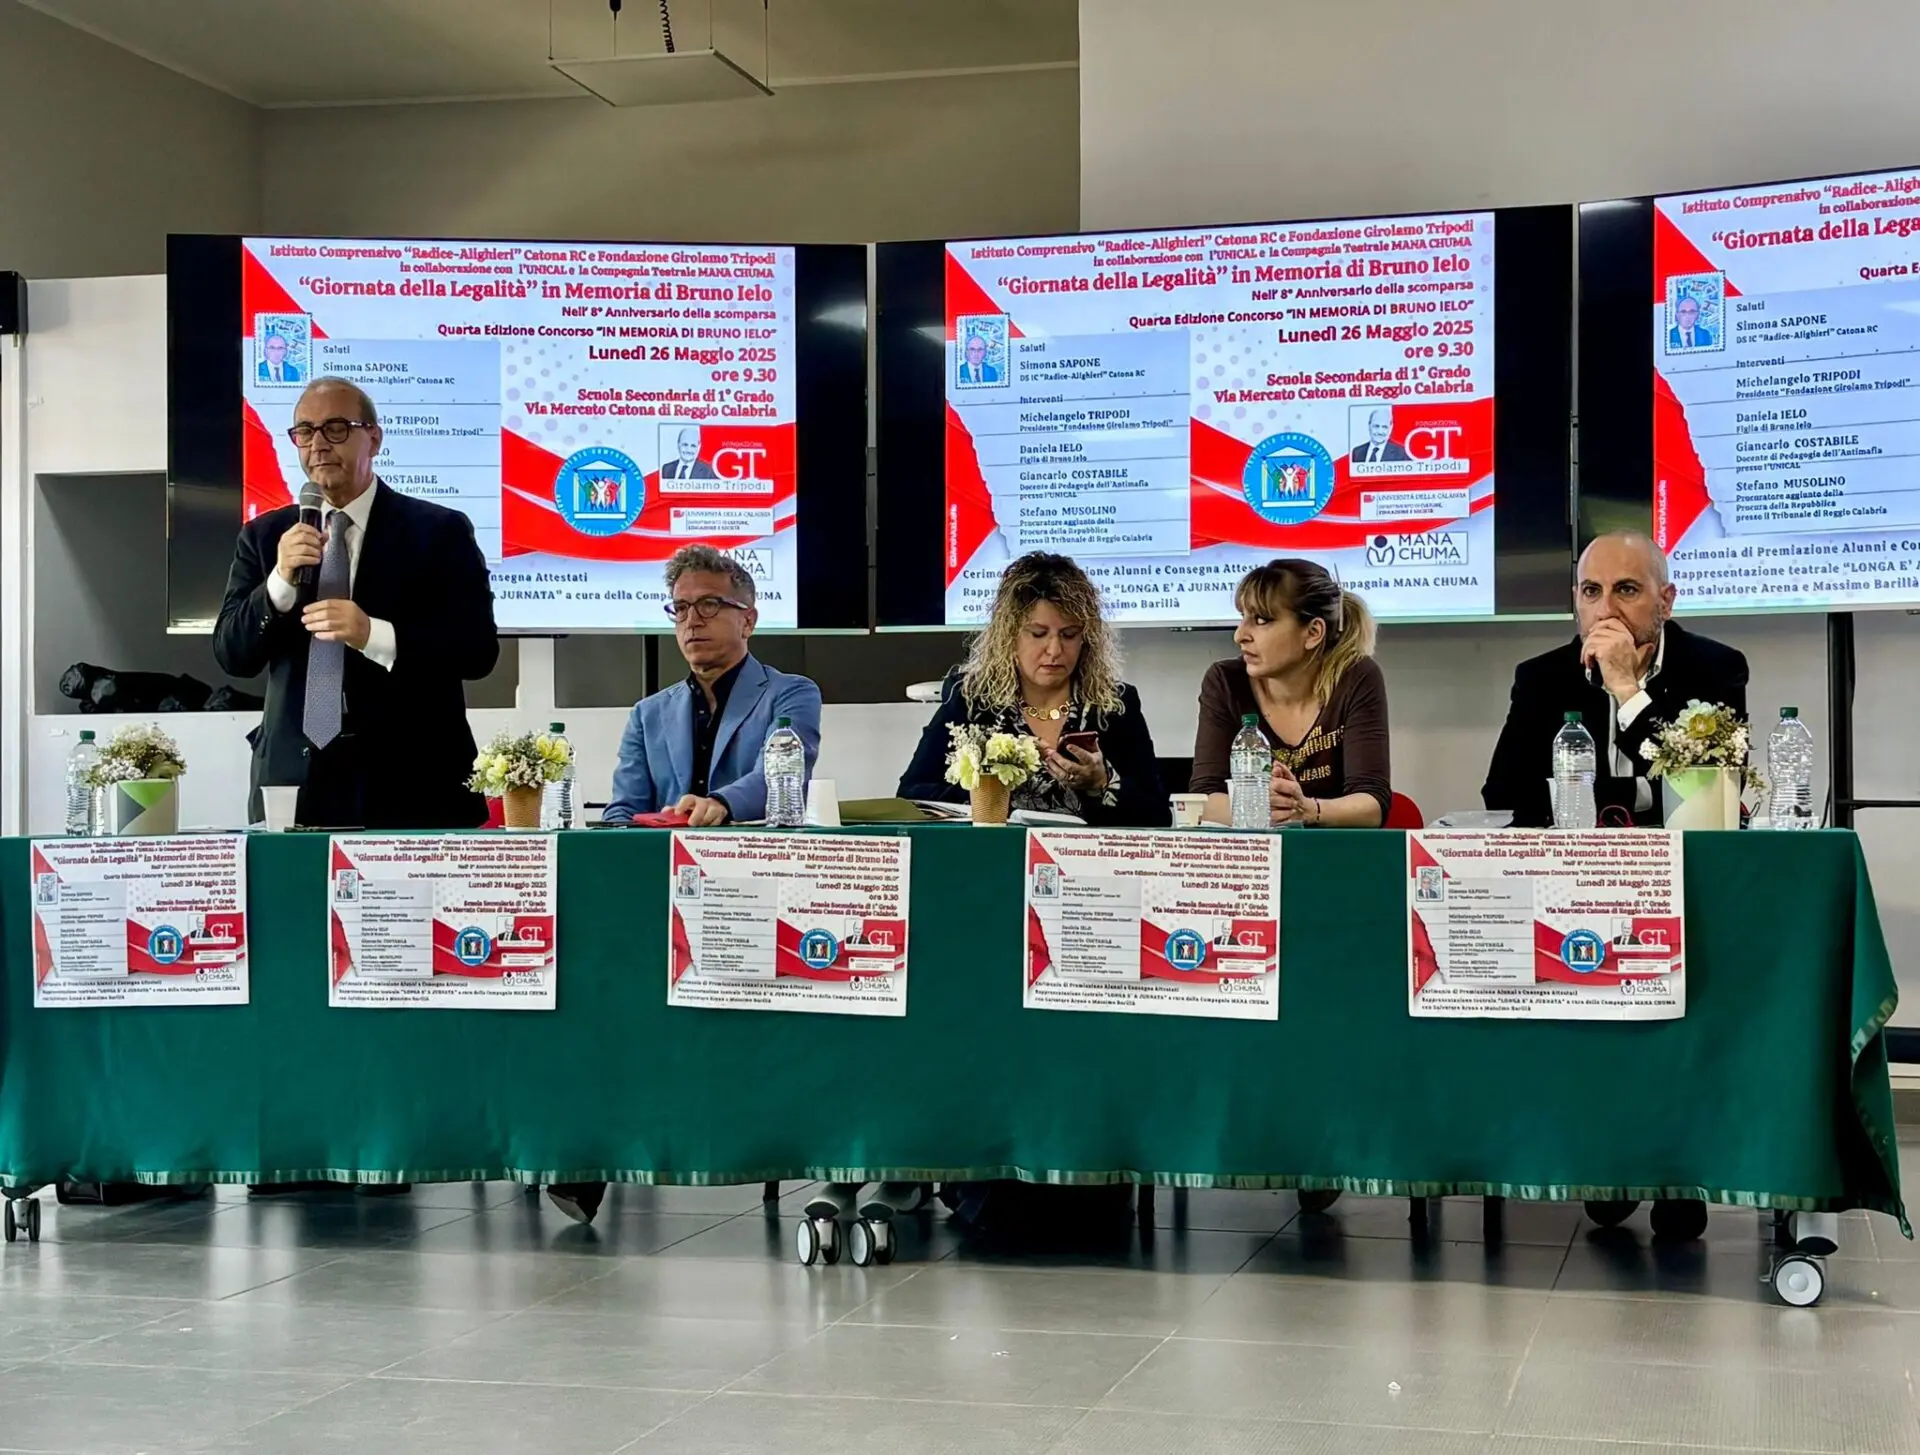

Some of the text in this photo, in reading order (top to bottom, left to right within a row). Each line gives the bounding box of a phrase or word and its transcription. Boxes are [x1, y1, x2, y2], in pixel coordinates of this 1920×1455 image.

[1683, 189, 1821, 214] Istituto Comprensivo
[1712, 219, 1870, 250] “Giornata della
[270, 245, 776, 267] Istituto Comprensivo “Radice-Alighieri” Catona RC e Fondazione Girolamo Tripodi
[998, 254, 1470, 294] “Giornata della Legalità” in Memoria di Bruno Ielo
[1860, 265, 1908, 280] Quarta
[299, 276, 772, 302] “Giornata della Legalità” in Memoria di Bruno Ielo
[1736, 314, 1827, 331] Simona SAPONE
[438, 324, 776, 339] Quarta Edizione Concorso “IN MEMORIA DI BRUNO IELO”
[1279, 320, 1474, 343] Lunedì 26 Maggio 2025
[589, 345, 776, 365] Lunedì 26 Maggio 2025
[1020, 343, 1045, 353] Saluti
[1404, 342, 1474, 359] ore 9.30
[323, 362, 408, 372] Simona SAPONE
[1020, 358, 1100, 370] Simona SAPONE
[711, 368, 777, 382] ore 9.30
[1736, 369, 1860, 388] Michelangelo TRIPODI
[1020, 394, 1064, 404] Interventi
[525, 402, 777, 420] Via Mercato Catona di Reggio Calabria
[1020, 410, 1130, 423] Michelangelo TRIPODI
[1737, 409, 1807, 423] Daniela IELO
[395, 416, 439, 425] TRIPODI
[1020, 443, 1083, 454] Daniela IELO
[1405, 427, 1462, 460] GT
[1736, 435, 1859, 452] Giancarlo COSTABILE
[712, 448, 767, 482] GT
[1356, 461, 1461, 473] Girolamo Tripodi
[1020, 469, 1128, 481] Giancarlo COSTABILE
[1736, 476, 1846, 491] Stefano MUSOLINO
[1020, 506, 1116, 517] Stefano MUSOLINO
[1736, 506, 1887, 523] presso il Tribunale di Reggio Calabria
[1399, 533, 1453, 546] MANA
[1399, 546, 1461, 560] CHUMA
[1673, 540, 1897, 561] Cerimonia di Premiazione Alunni e
[536, 572, 588, 582] Attestati
[1672, 559, 1912, 582] Rappresentazione teatrale “LONGA E'
[1114, 582, 1185, 593] “LONGA E' A
[1394, 577, 1478, 587] MANA CHUMA
[1698, 576, 1918, 595] Salvatore Arena e Massimo Barillà
[500, 590, 562, 600] JURNATA”
[604, 590, 632, 600] della
[1141, 598, 1180, 609] Barillà
